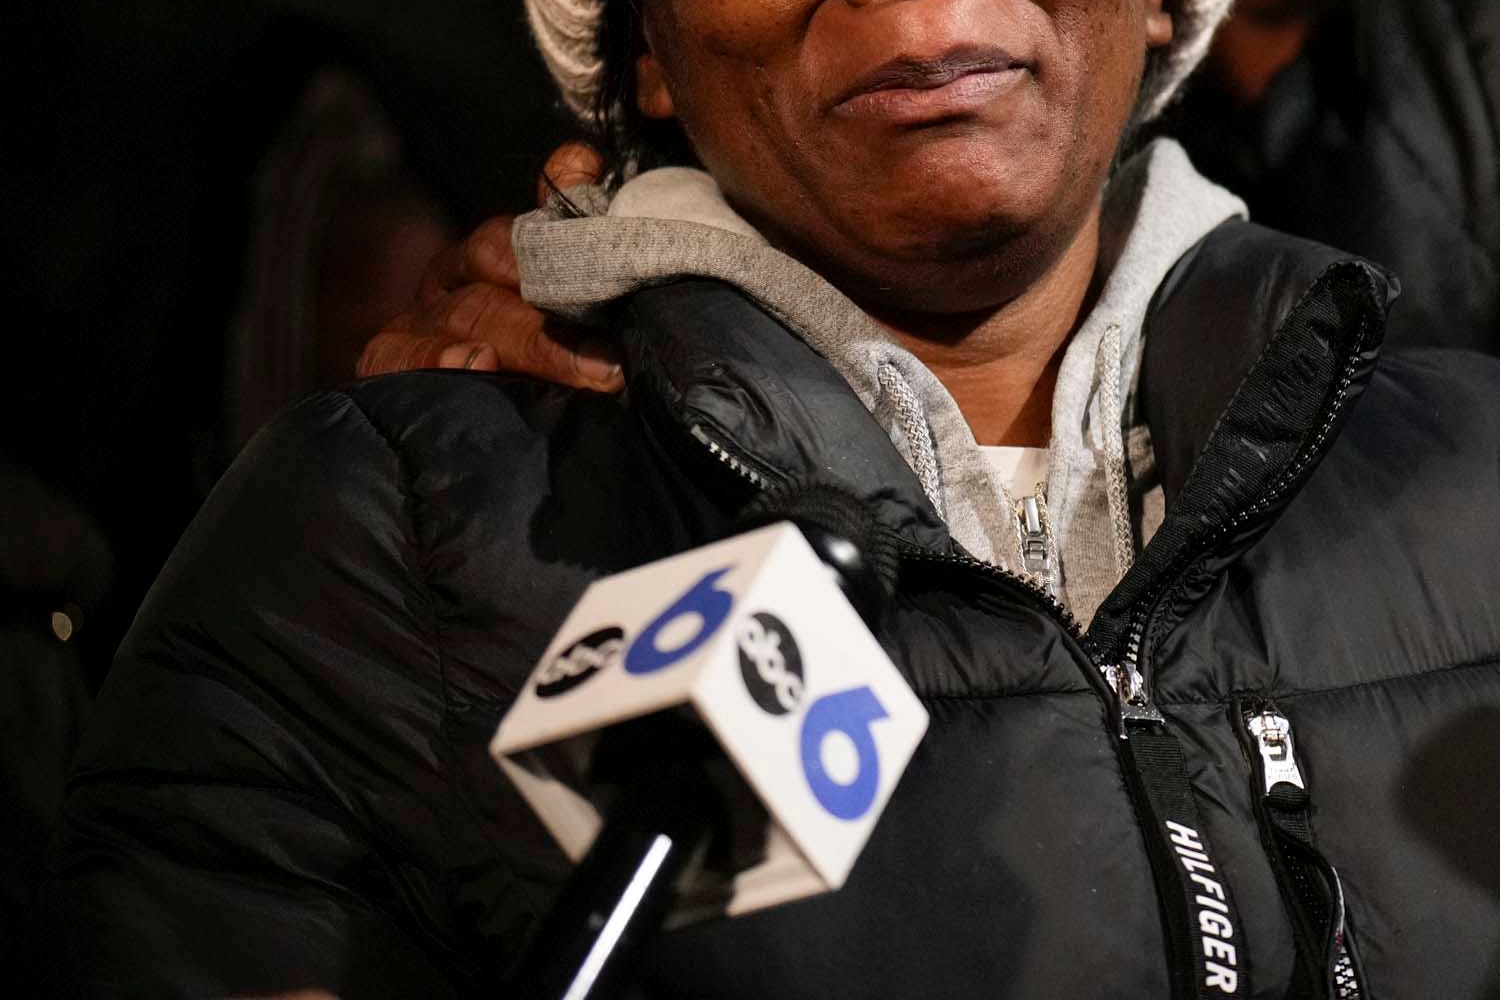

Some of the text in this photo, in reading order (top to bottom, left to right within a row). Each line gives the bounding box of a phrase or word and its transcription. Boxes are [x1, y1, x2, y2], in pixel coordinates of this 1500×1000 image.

[624, 566, 736, 676] 6
[736, 612, 890, 823] abc 6
[1165, 819, 1238, 994] HILFIGER
